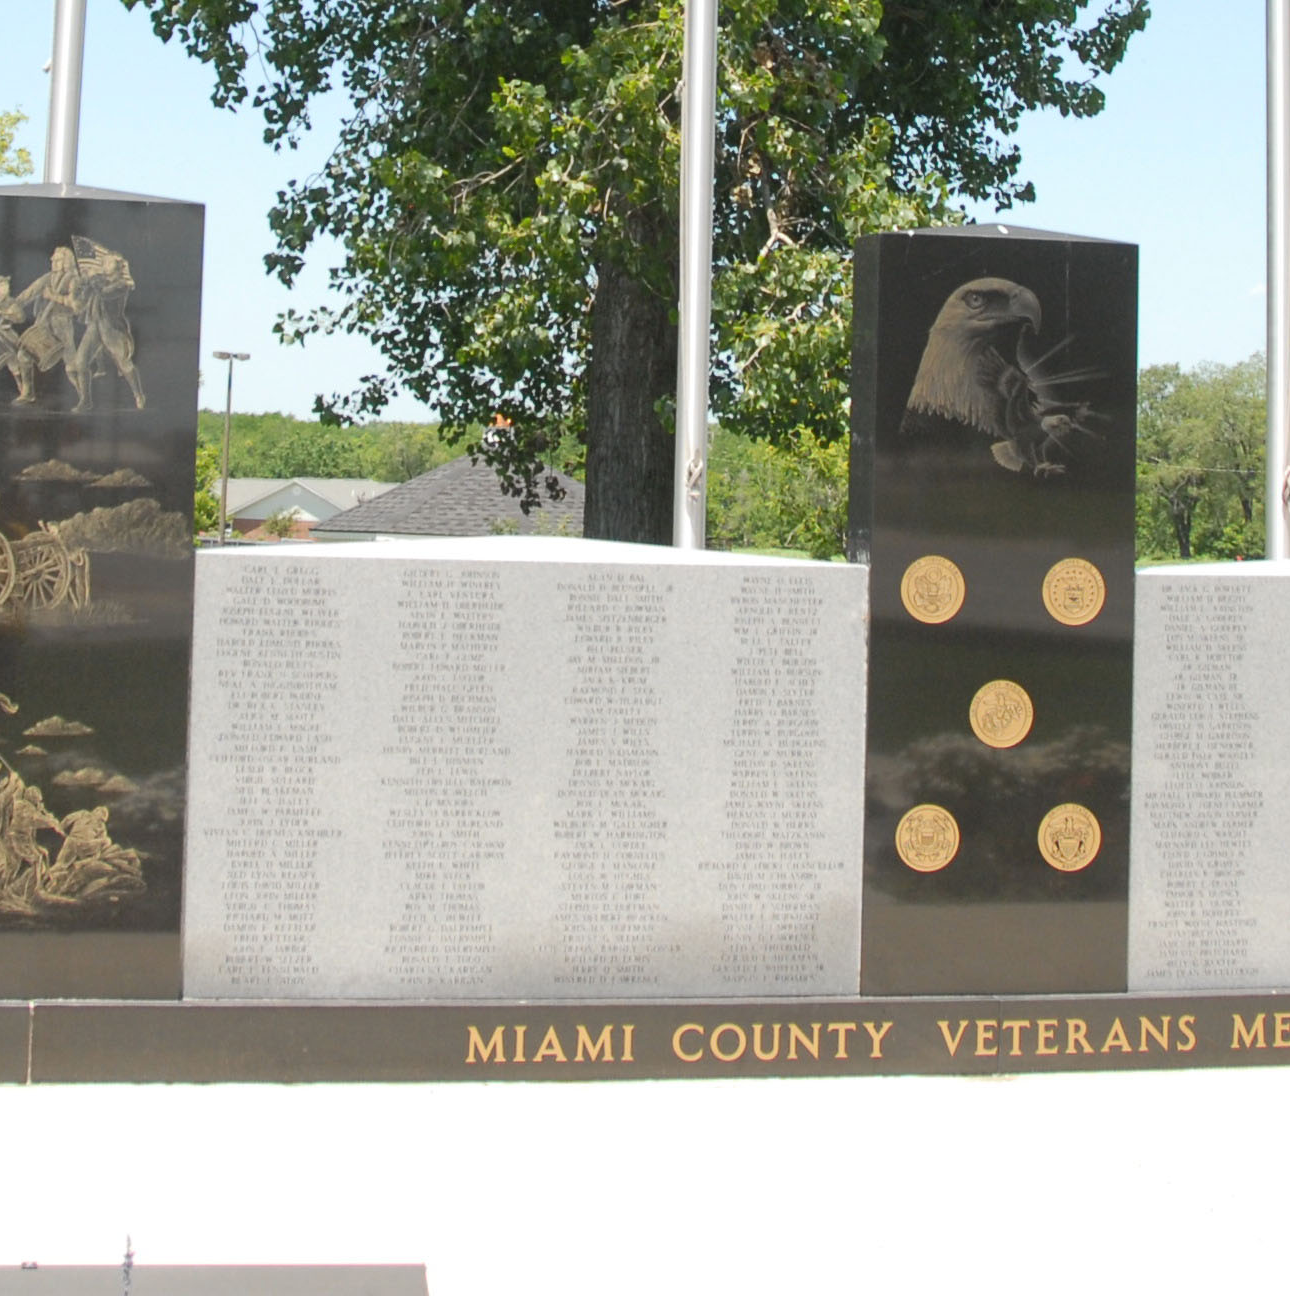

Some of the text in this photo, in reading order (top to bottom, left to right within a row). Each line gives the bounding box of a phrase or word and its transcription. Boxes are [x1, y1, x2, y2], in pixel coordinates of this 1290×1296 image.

[465, 1024, 636, 1064] MIAMI
[672, 1022, 894, 1062] COUNTY
[938, 1014, 1198, 1057] VETERANS
